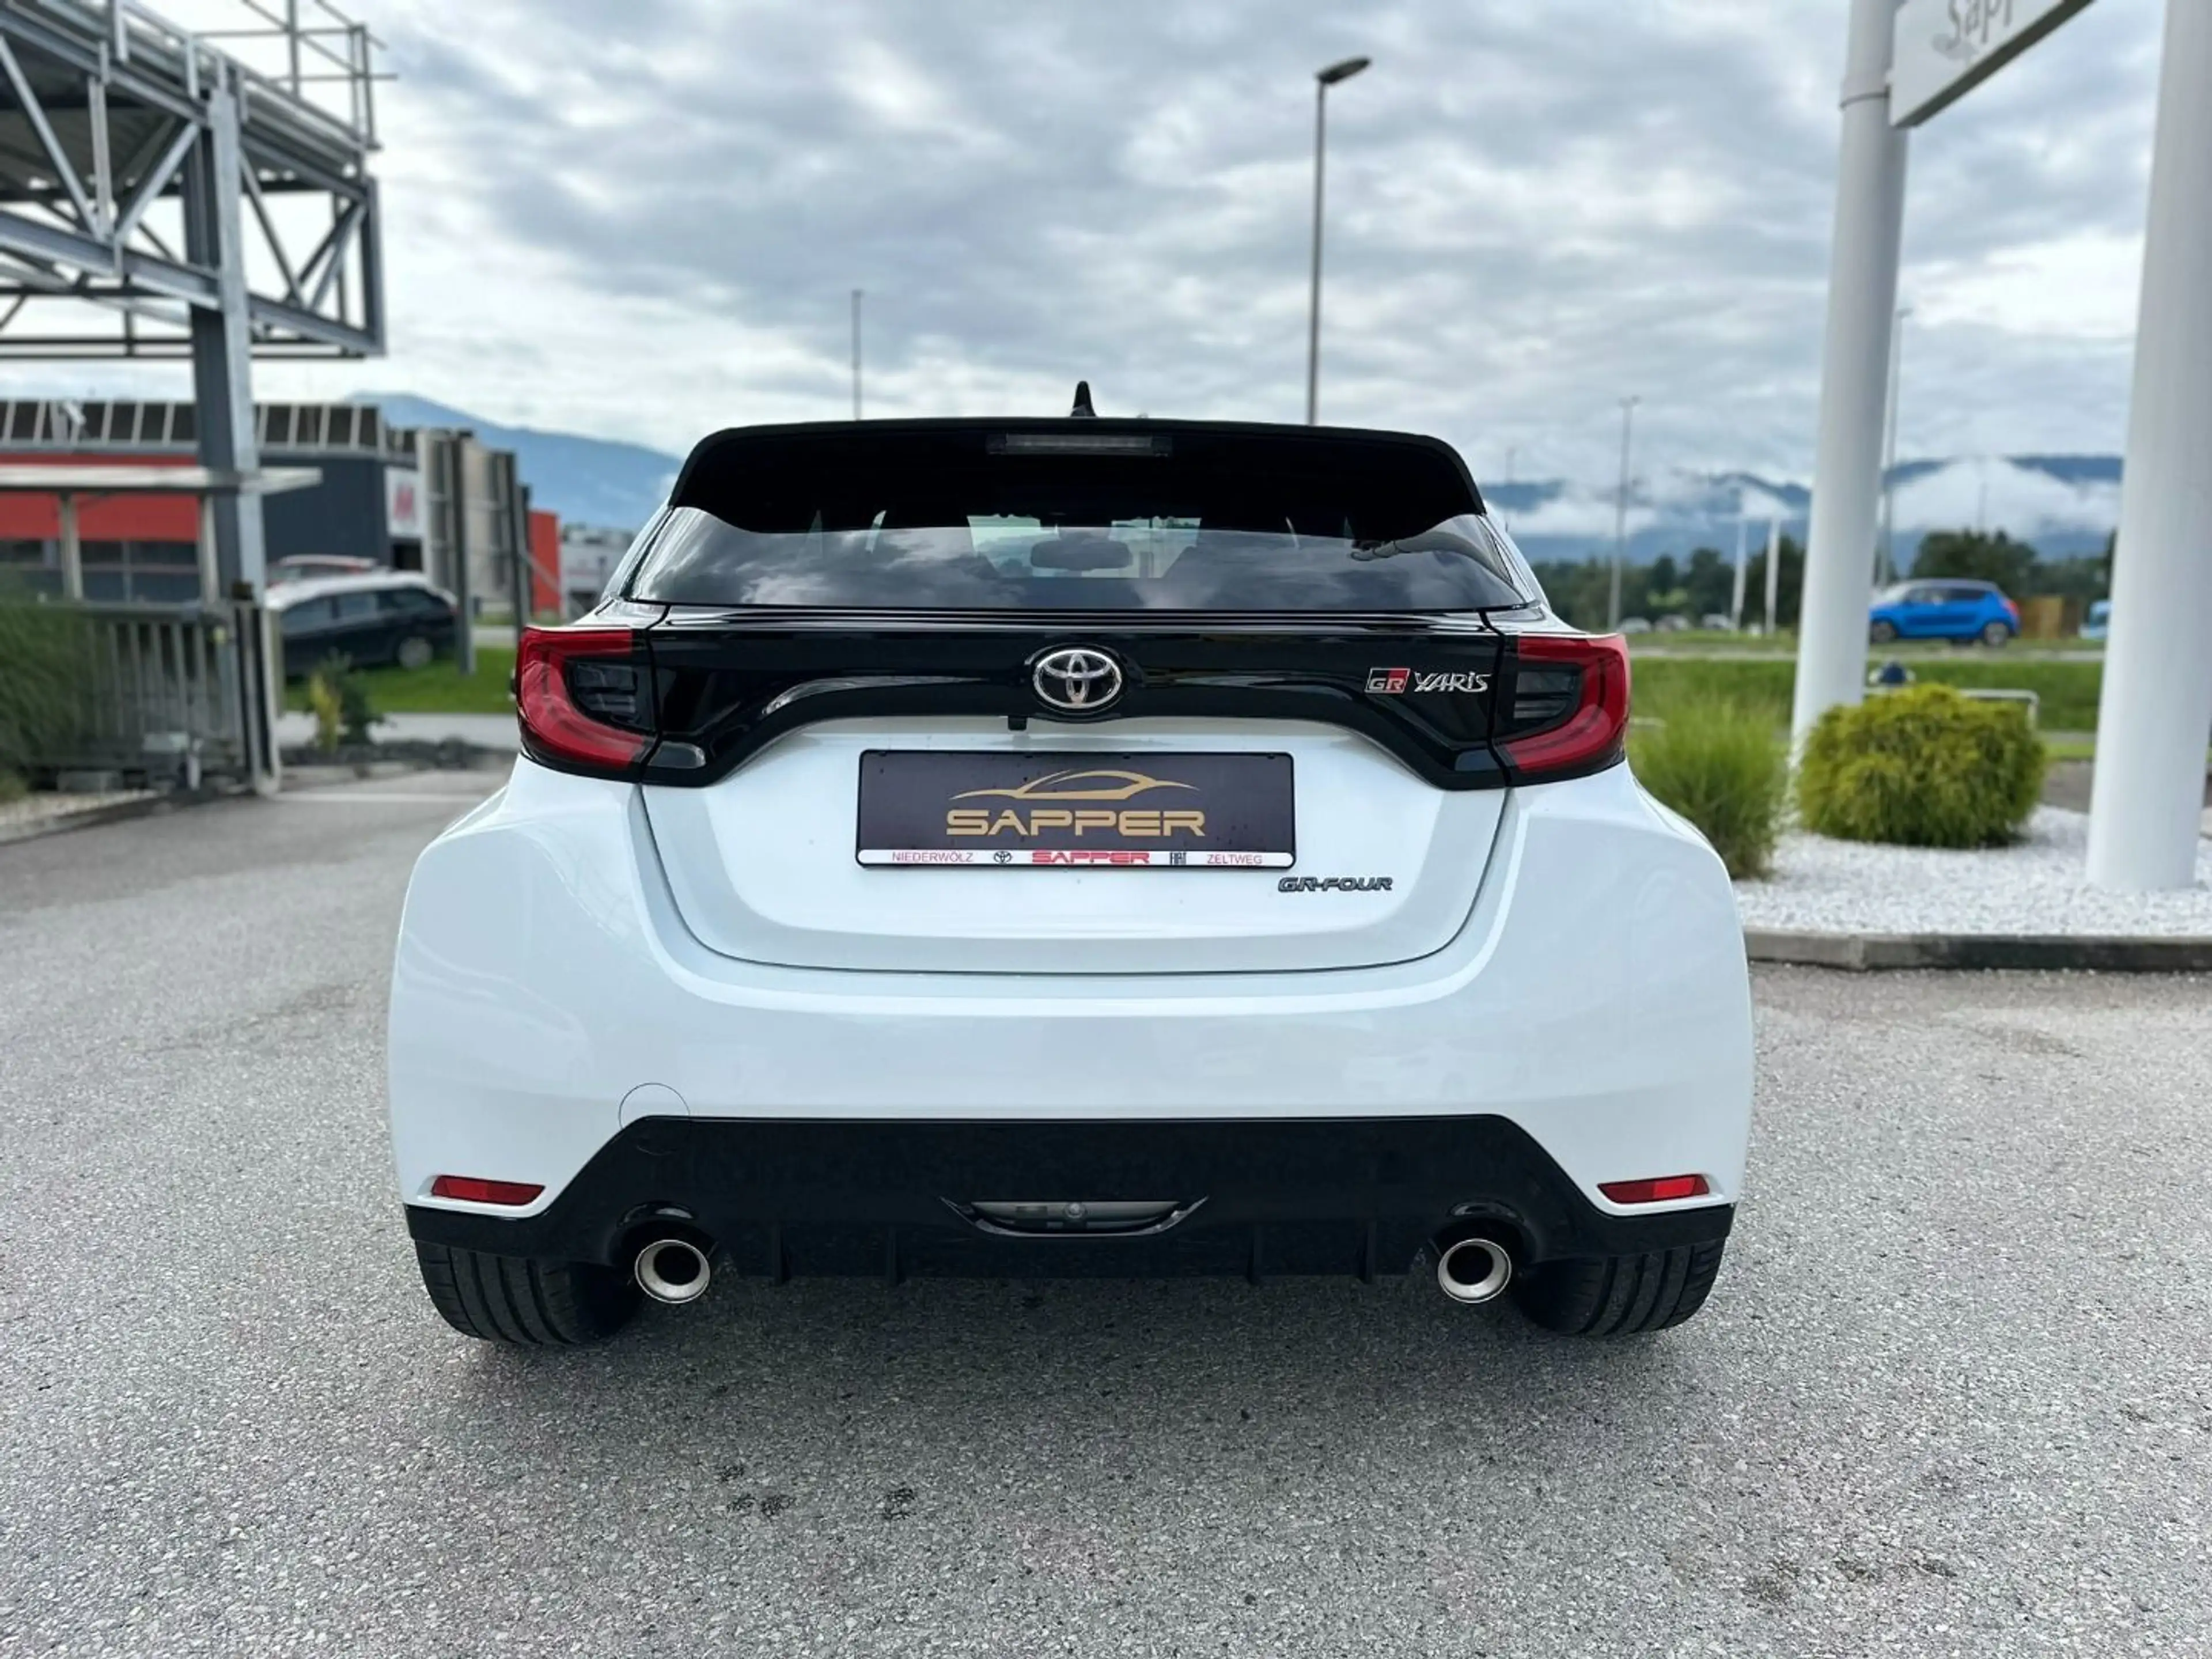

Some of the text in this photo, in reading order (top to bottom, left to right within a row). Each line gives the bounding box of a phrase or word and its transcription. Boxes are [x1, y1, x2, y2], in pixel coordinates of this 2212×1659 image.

[1368, 675, 1407, 691] GR
[946, 809, 1206, 836] SAPPER
[1032, 850, 1150, 864] SAPPER
[1207, 854, 1263, 864] ZELTWEG
[1278, 876, 1393, 892] GR-FOUR
